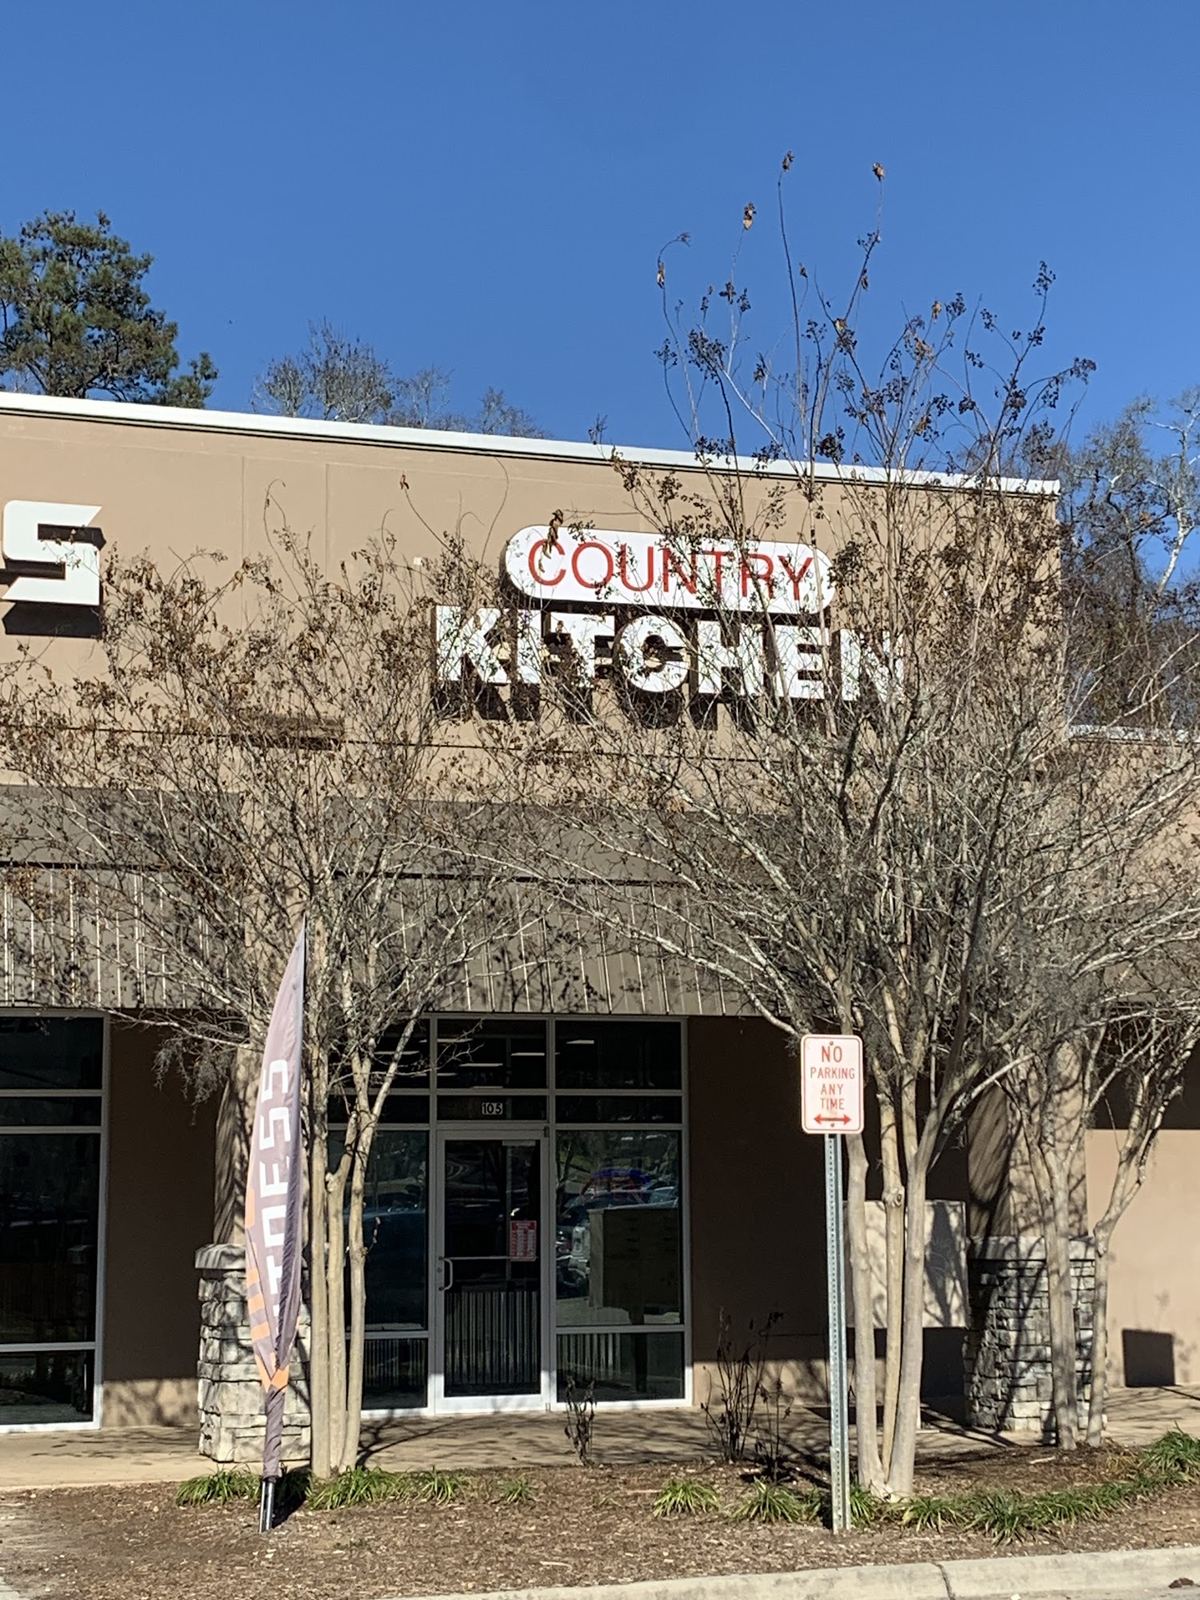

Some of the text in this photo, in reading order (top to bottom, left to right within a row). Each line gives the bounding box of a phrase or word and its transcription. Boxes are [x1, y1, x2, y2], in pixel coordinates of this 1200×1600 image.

[528, 539, 814, 602] COUNTRY
[436, 605, 904, 702] KITCHEN
[821, 1046, 843, 1063] NO
[810, 1067, 856, 1080] PARKING
[820, 1083, 844, 1096] ANY
[481, 1103, 502, 1114] 105
[820, 1098, 845, 1111] TIME
